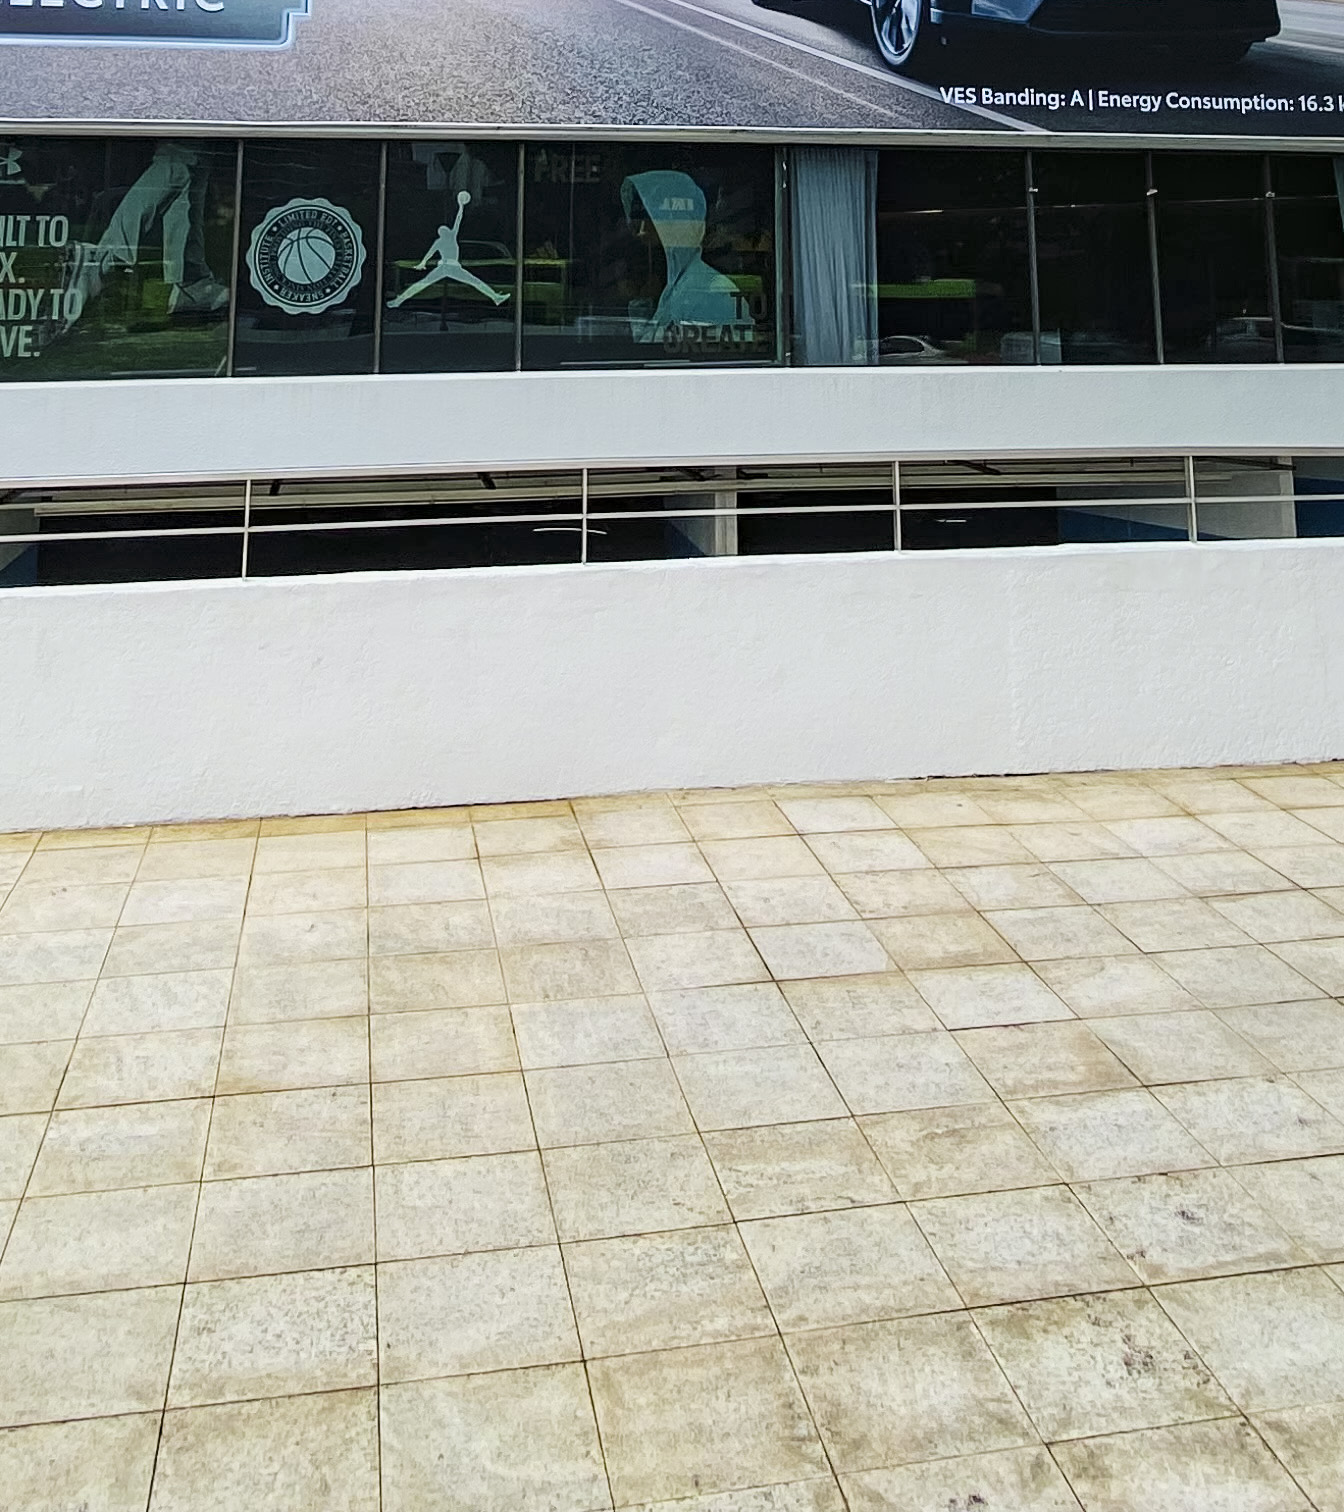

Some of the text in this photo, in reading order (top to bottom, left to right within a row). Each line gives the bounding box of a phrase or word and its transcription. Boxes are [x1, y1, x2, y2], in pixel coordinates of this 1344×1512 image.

[939, 87, 977, 105] VES
[981, 88, 1066, 110] Banding:
[1070, 89, 1084, 106] A
[1098, 91, 1162, 112] Energy
[1166, 92, 1295, 115] Consumption:
[1297, 95, 1335, 112] 16.3
[36, 215, 69, 248] TO
[278, 210, 318, 228] LIMITED
[259, 235, 275, 285] INSTITUTE
[50, 288, 83, 321] TO
